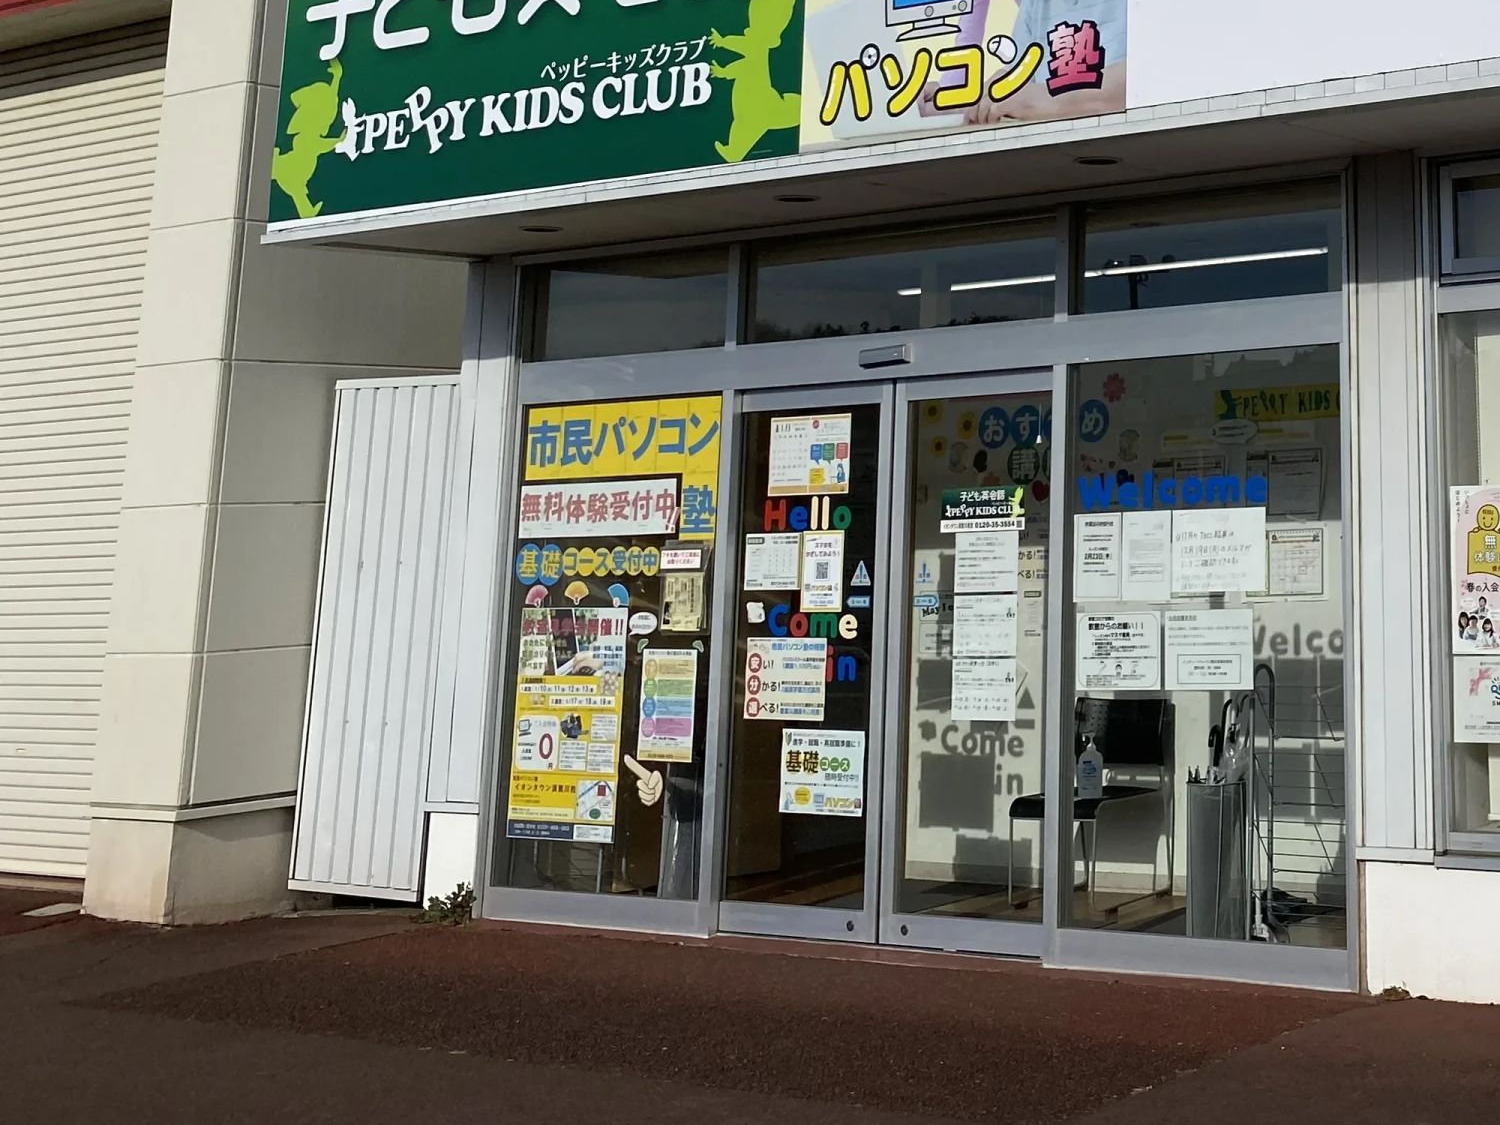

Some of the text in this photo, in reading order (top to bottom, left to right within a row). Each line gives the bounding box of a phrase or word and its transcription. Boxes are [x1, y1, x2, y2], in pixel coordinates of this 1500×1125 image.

[540, 35, 708, 82] ペッピーキッズクラブ
[819, 19, 1106, 126] パソコン塾
[360, 60, 714, 155] PEPPY KIDS CLUB
[528, 412, 720, 468] 市民パソコン
[679, 484, 717, 534] 塾
[950, 504, 976, 518] PEPPY
[976, 506, 997, 516] KIDS
[1077, 469, 1267, 512] Welcome
[764, 495, 852, 532] Hello
[767, 602, 858, 640] Come
[826, 644, 857, 683] in
